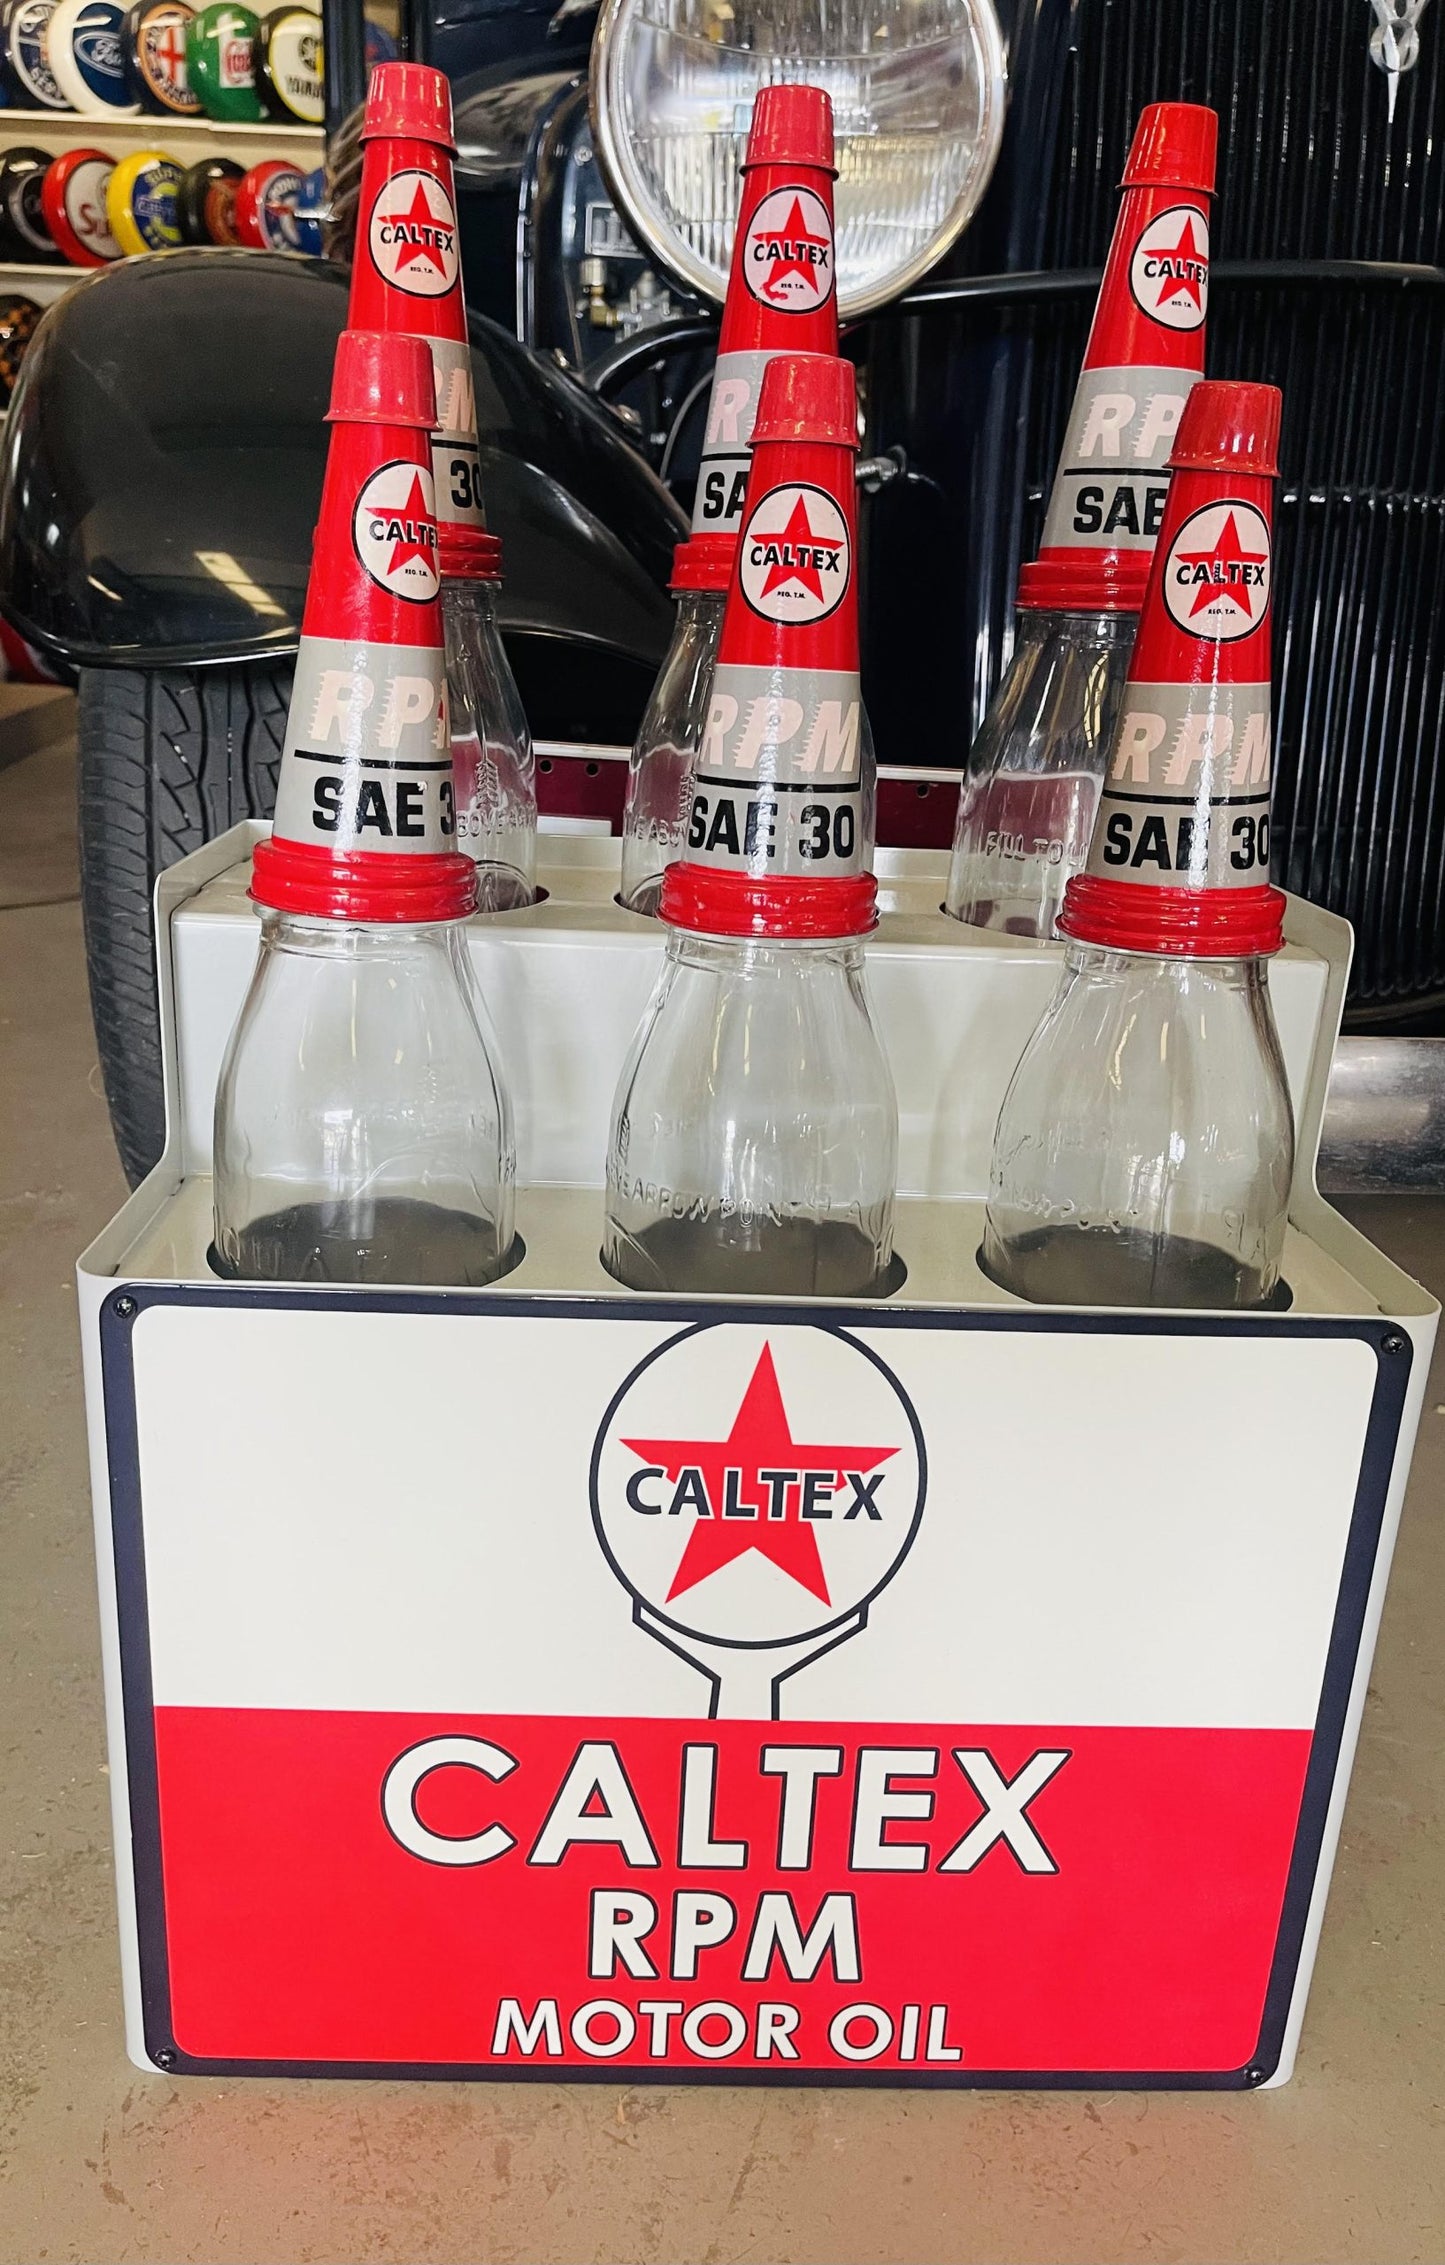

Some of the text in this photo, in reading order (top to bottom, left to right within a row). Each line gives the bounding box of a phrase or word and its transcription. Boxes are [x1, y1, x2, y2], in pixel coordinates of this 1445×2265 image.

[380, 225, 454, 254] CALTEX
[753, 242, 828, 269] CALTEX
[750, 545, 840, 573] CALTEX
[1176, 563, 1265, 587] CALTEX
[699, 693, 860, 773] RPM
[1110, 711, 1271, 785] RPM
[312, 776, 425, 838] SAE
[688, 795, 778, 858] SAE
[798, 804, 855, 860] 30
[985, 830, 1027, 862] FILL
[1032, 837, 1064, 866] TO
[1230, 813, 1270, 871] 30
[625, 1467, 886, 1521] CALTEX
[381, 1734, 1071, 1876] CALTEX
[588, 1888, 862, 1983] RPM
[491, 1997, 963, 2062] MOTOR OIL
